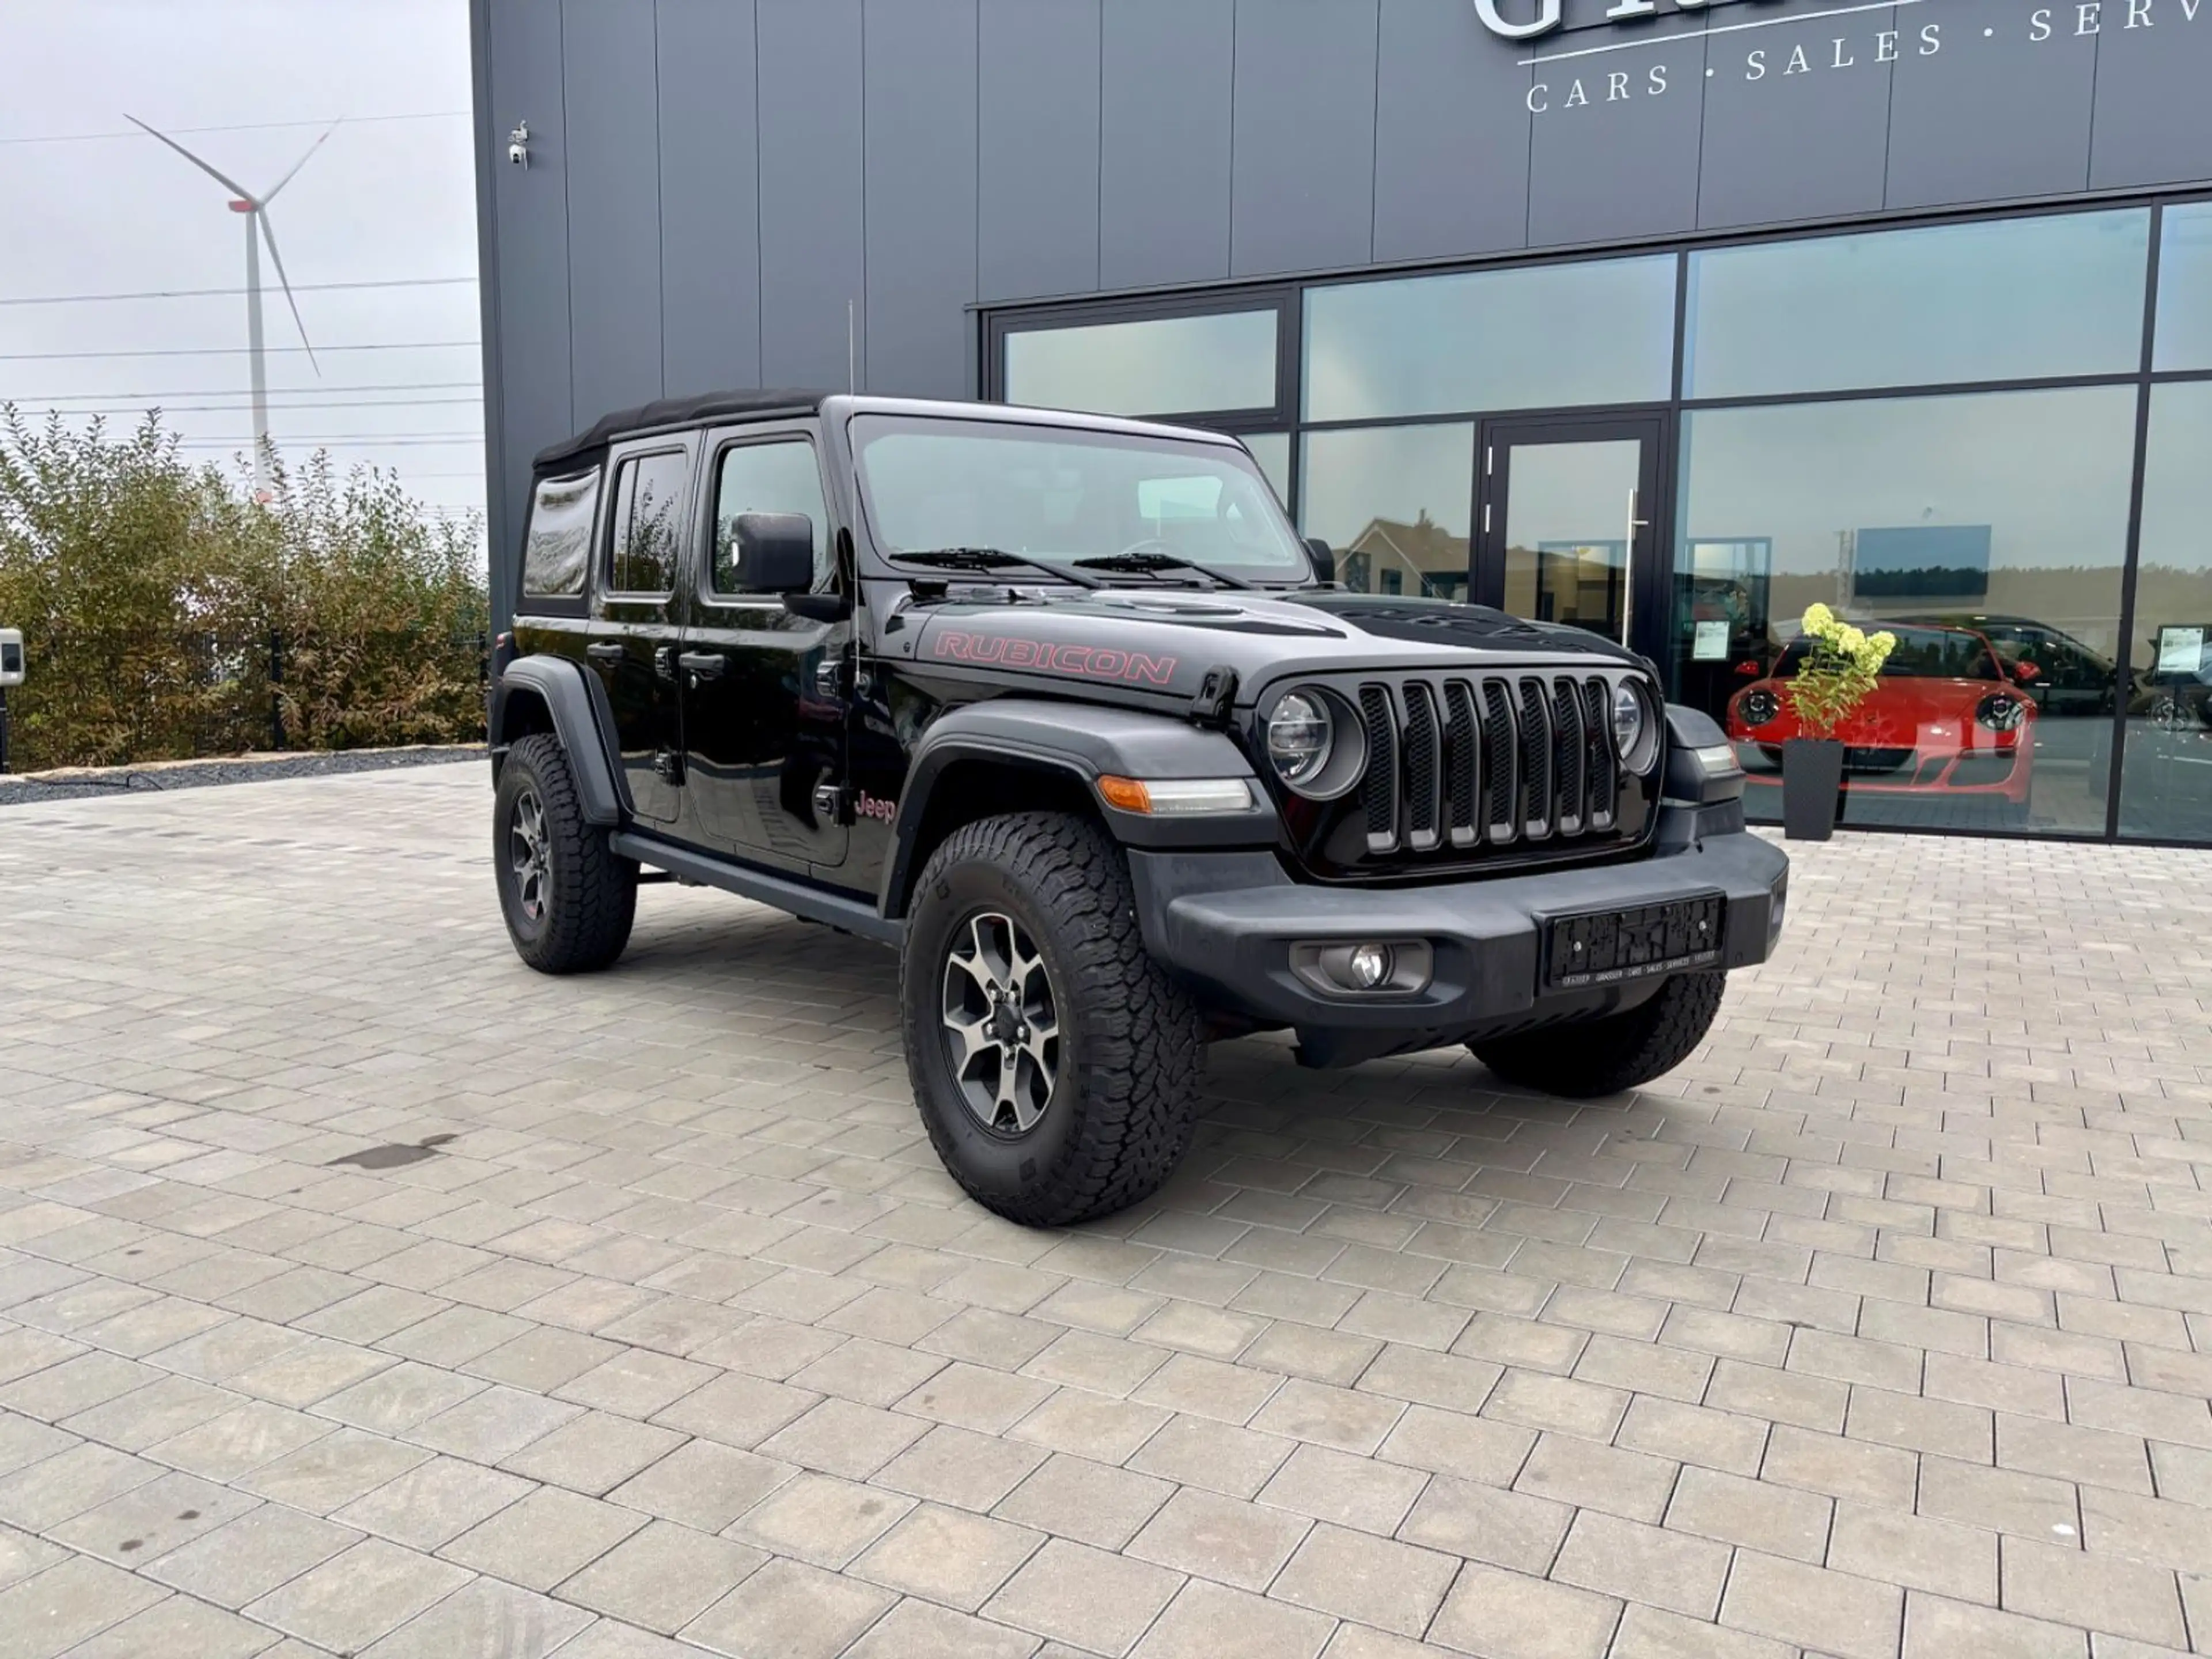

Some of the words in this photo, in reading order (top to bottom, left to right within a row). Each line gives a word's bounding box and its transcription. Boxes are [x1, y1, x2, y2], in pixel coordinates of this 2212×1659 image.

[1526, 65, 1668, 112] CARS
[1746, 24, 1940, 80] SALES
[934, 630, 1177, 684] RUBICON
[854, 789, 896, 825] Jeep
